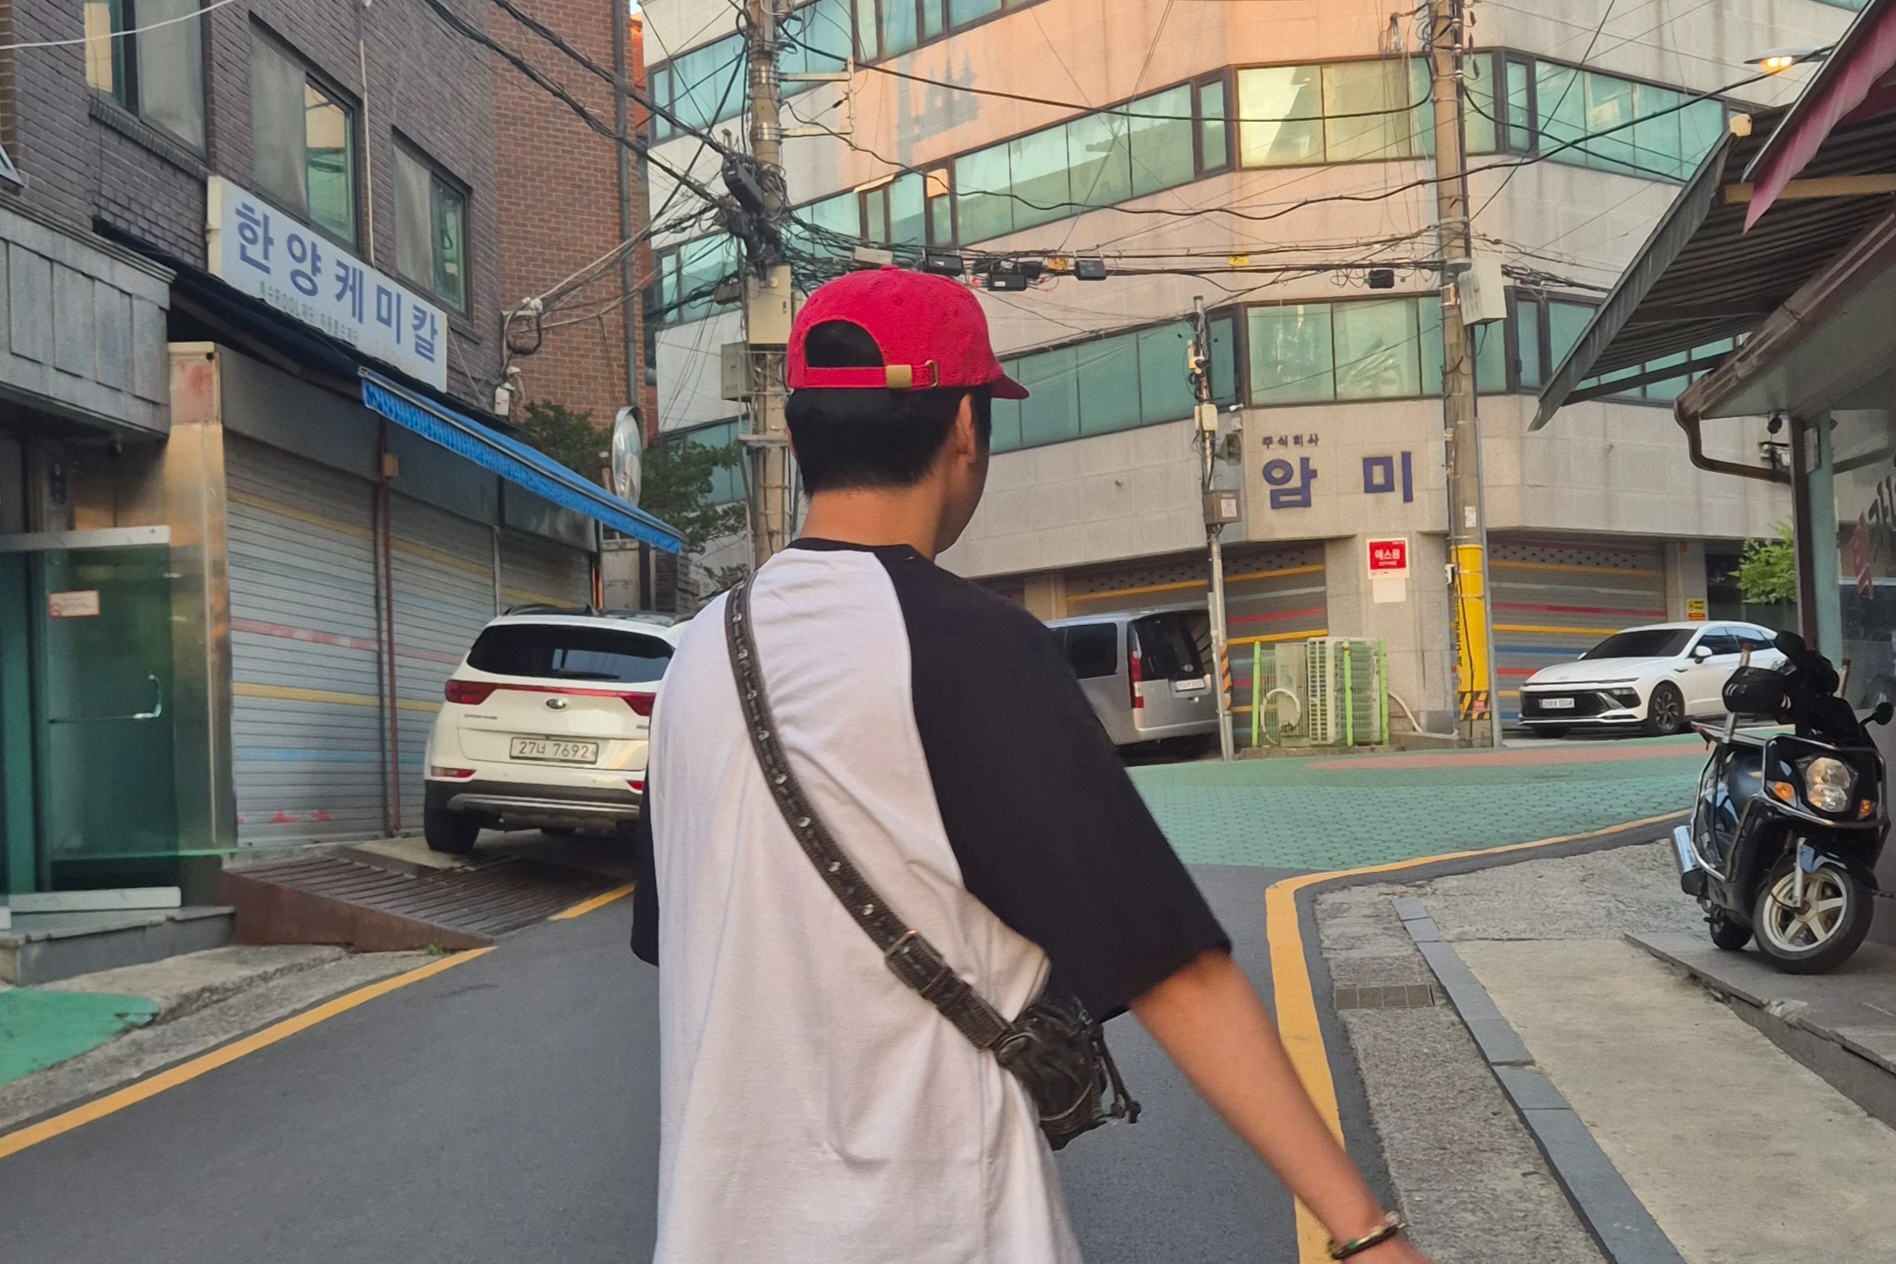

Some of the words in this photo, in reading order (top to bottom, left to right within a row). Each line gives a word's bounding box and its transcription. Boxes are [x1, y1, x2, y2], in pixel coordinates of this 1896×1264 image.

[235, 202, 439, 364] 한양케미칼
[1262, 433, 1319, 449] 주식회사
[553, 743, 590, 759] 7692
